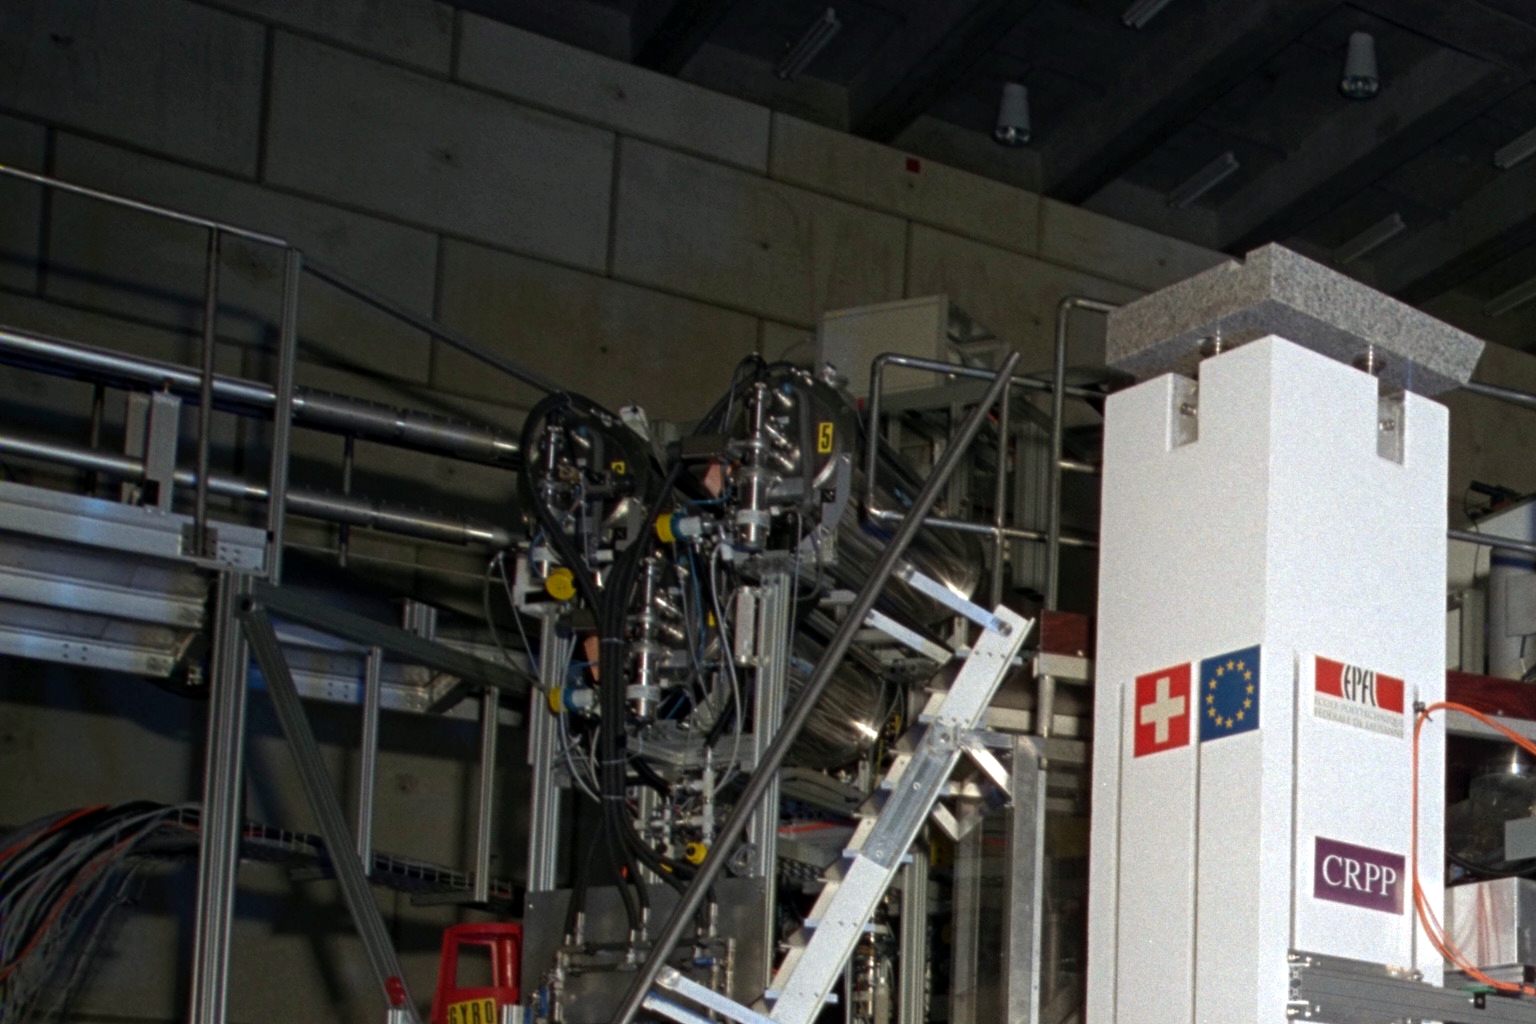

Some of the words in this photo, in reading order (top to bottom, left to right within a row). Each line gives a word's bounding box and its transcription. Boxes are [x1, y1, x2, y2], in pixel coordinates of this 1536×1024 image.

[820, 424, 830, 449] 5
[1343, 664, 1376, 707] EPFL
[1322, 854, 1397, 896] CRPP
